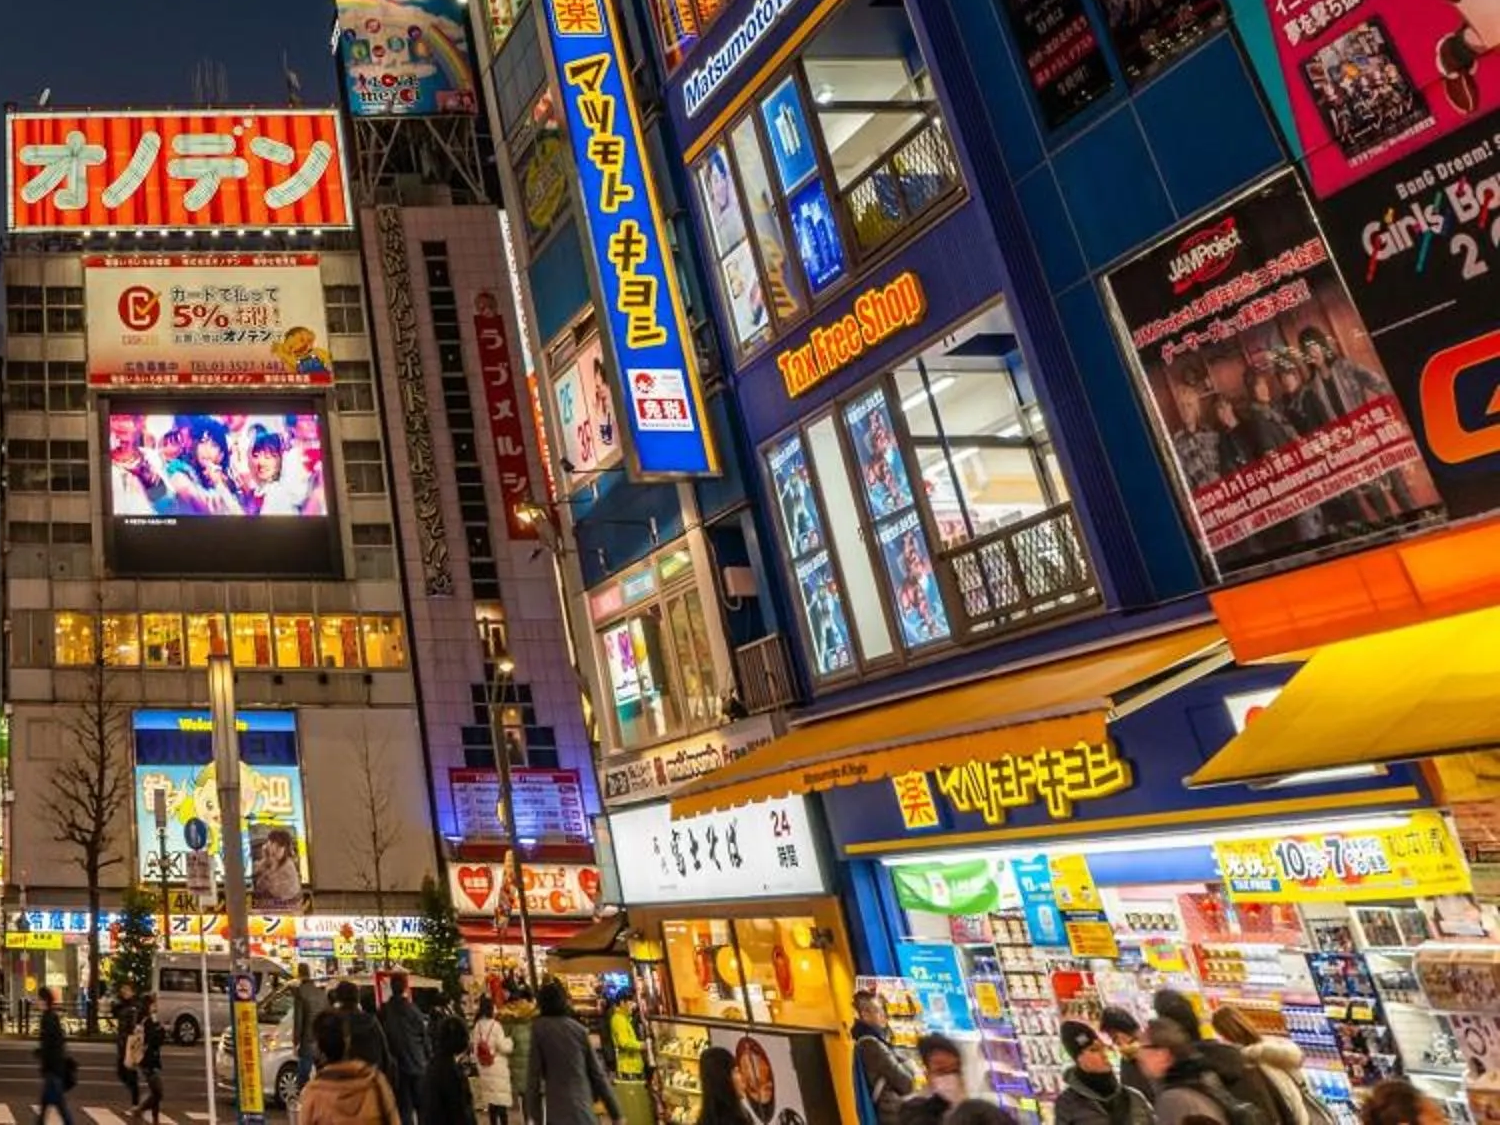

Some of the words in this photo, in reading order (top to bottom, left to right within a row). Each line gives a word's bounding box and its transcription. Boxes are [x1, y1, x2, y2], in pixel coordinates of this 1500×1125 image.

[18, 118, 332, 212] オノデン
[564, 53, 668, 349] マツモトキヨシ
[777, 338, 815, 400] Tax
[811, 315, 860, 380] Free
[855, 272, 927, 347] Shop
[769, 809, 792, 839] 24
